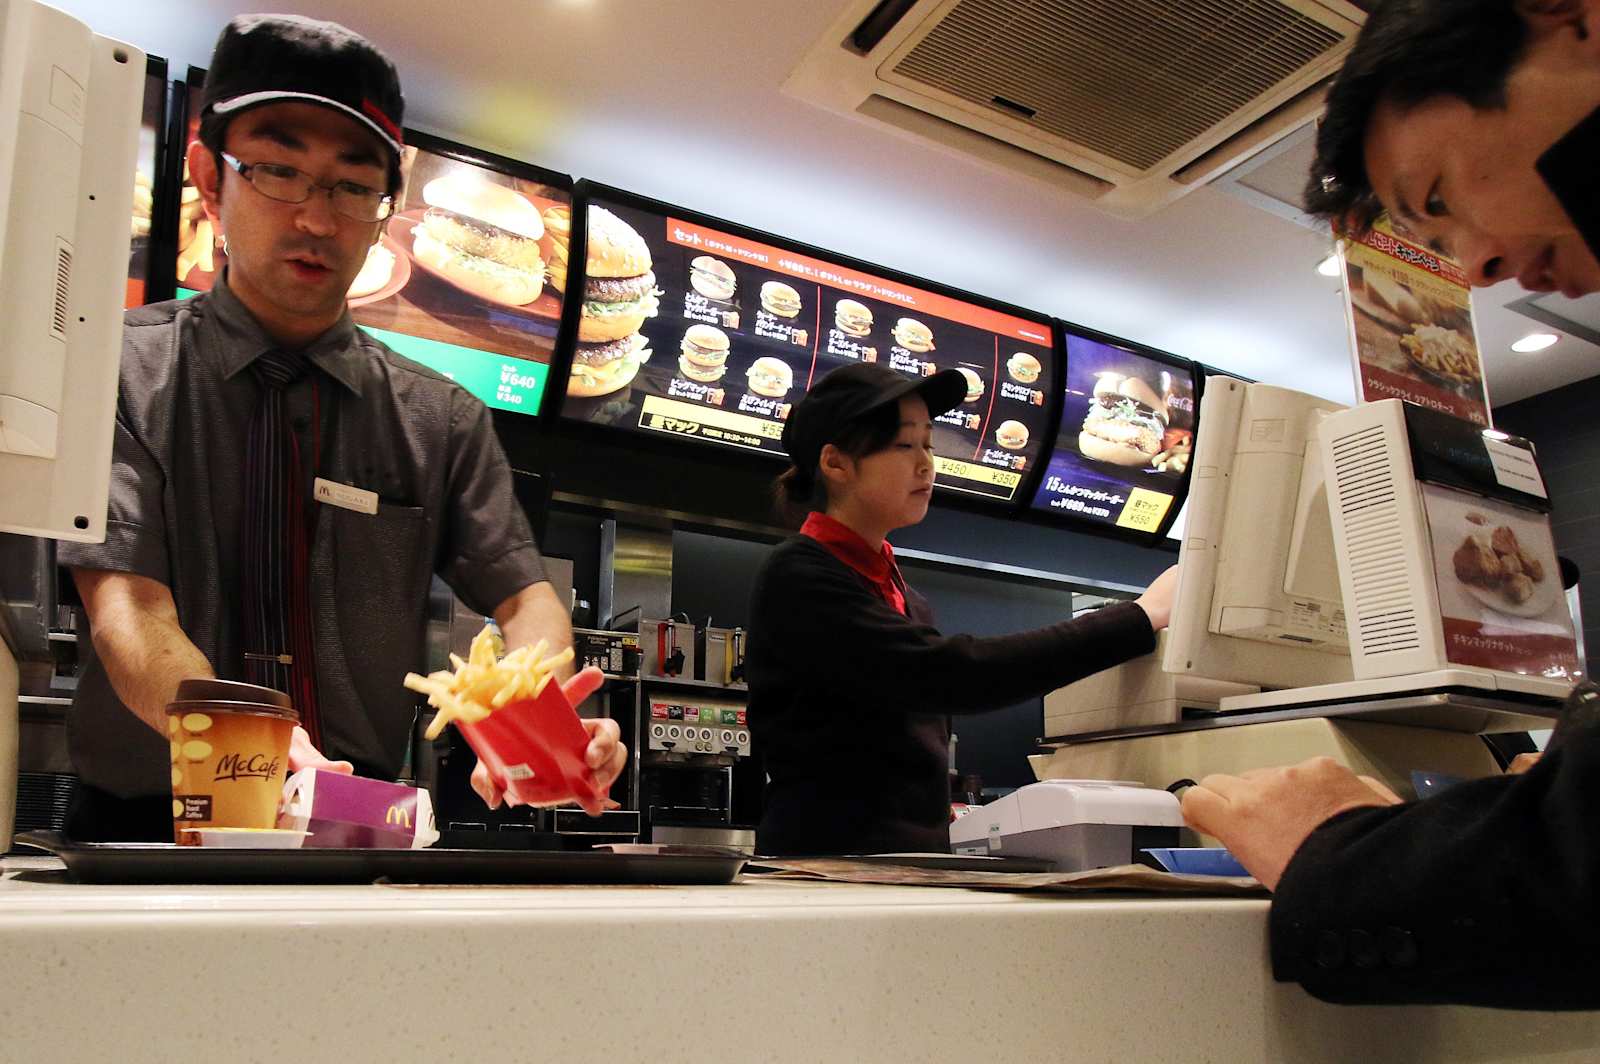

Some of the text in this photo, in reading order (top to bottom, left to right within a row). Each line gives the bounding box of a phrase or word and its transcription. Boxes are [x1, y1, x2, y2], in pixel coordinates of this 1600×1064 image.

[674, 228, 702, 245] セット
[501, 372, 536, 390] ¥640
[670, 378, 709, 394] ビッグマック
[496, 391, 522, 404] ¥340
[942, 460, 967, 476] ¥450
[992, 472, 1017, 486] ¥350
[214, 753, 279, 781] McCafé
